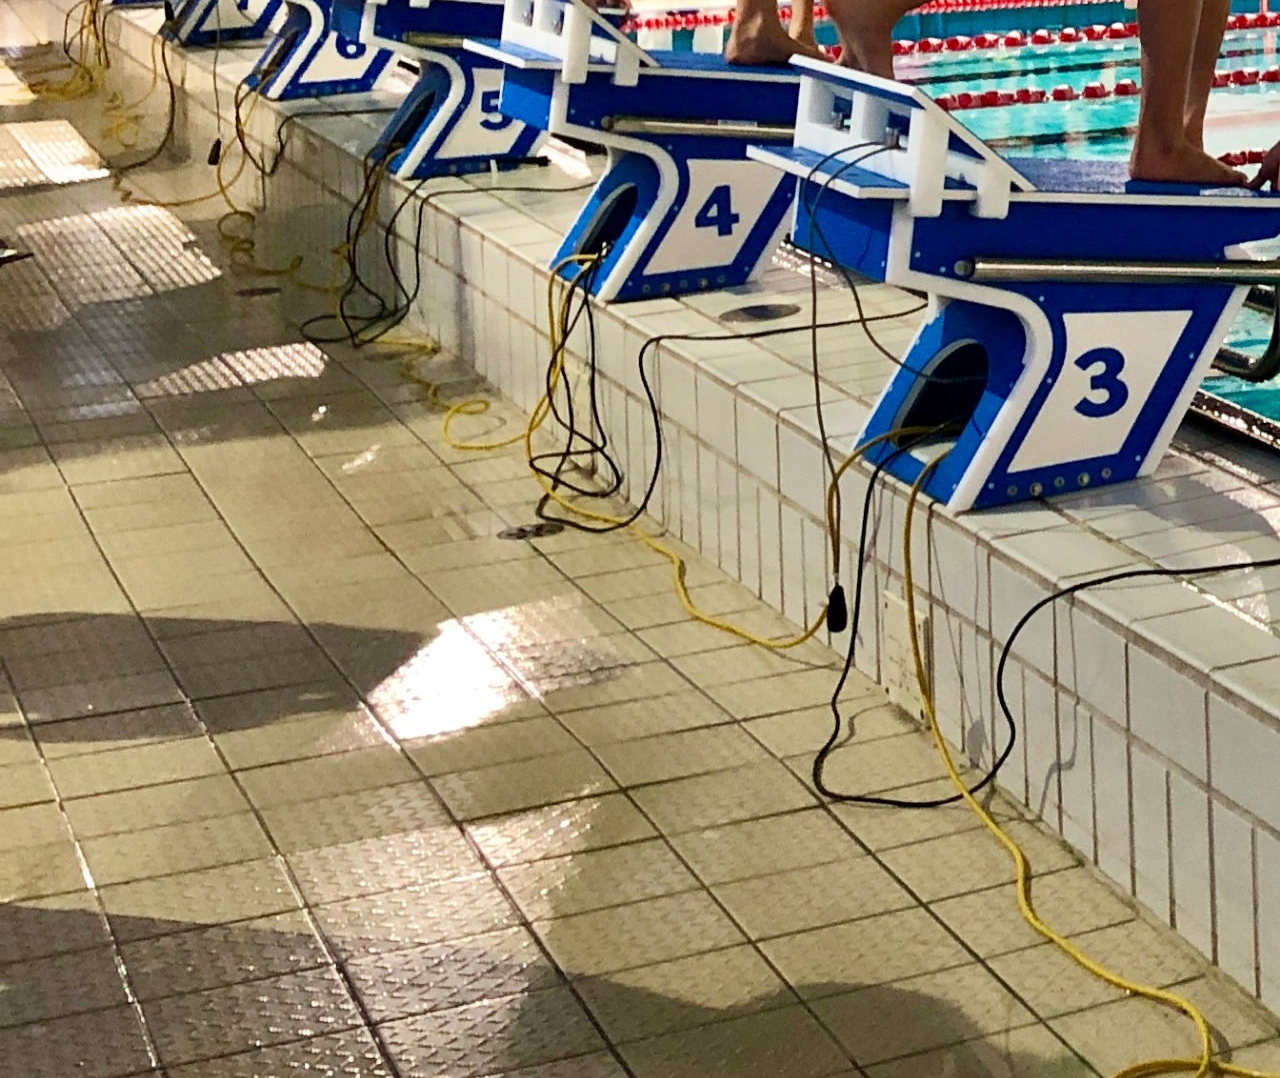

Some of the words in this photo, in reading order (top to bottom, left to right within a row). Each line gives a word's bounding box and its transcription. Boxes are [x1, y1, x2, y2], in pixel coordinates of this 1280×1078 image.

[480, 90, 513, 130] 5
[695, 185, 739, 236] 4
[1074, 347, 1128, 417] 3
